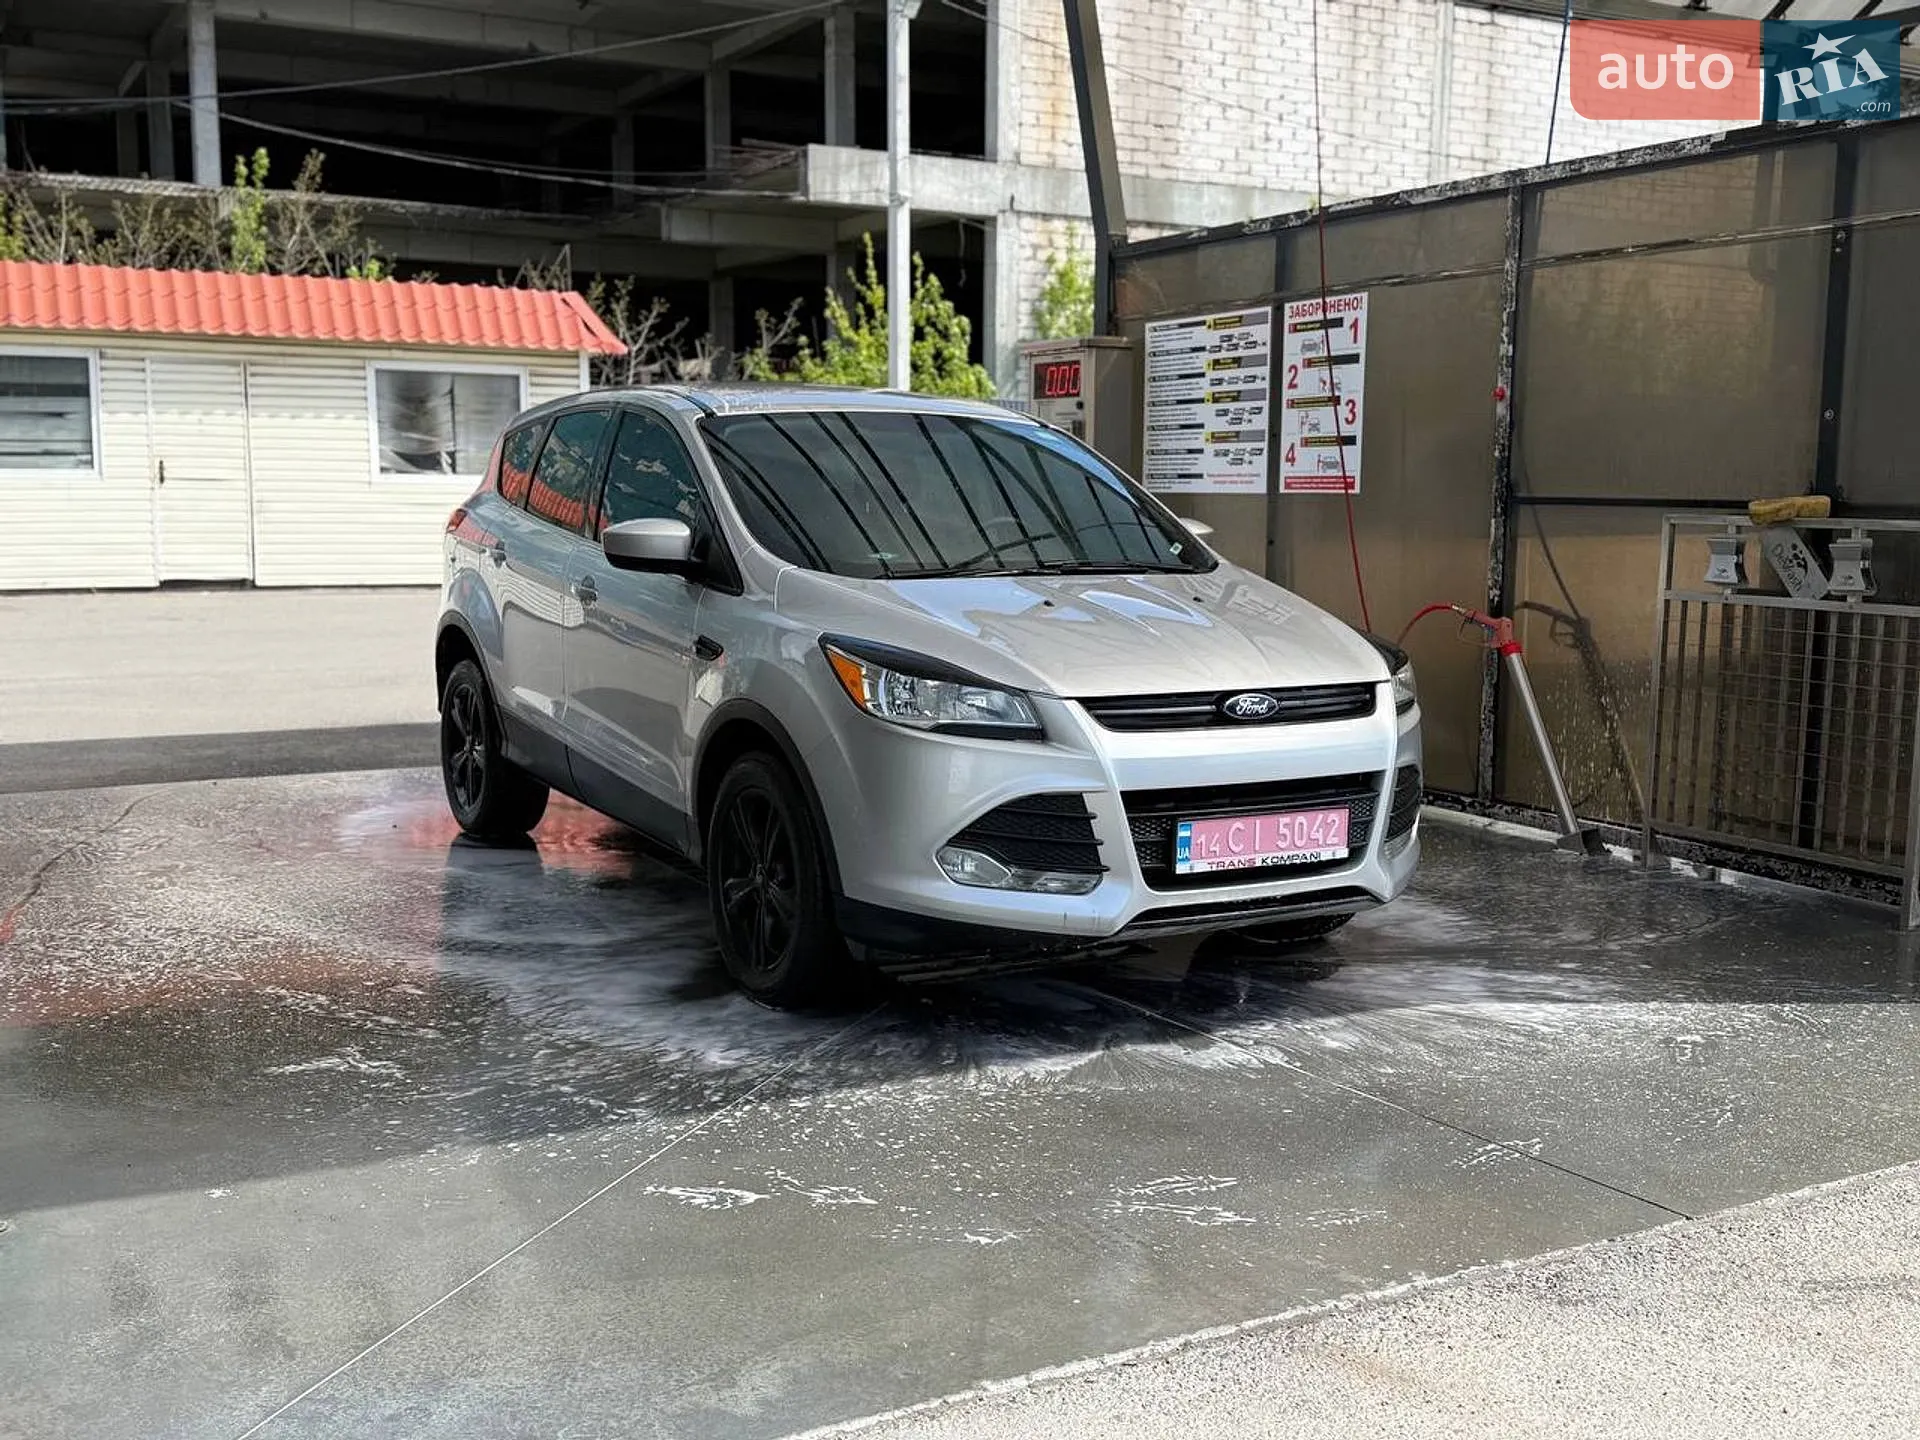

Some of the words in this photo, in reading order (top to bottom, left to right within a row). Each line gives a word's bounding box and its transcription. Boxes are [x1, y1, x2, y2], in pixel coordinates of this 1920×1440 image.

[1349, 317, 1359, 344] 1
[1287, 364, 1298, 389] 2
[1344, 398, 1356, 425] 3
[1285, 442, 1296, 467] 4
[1236, 697, 1269, 715] Ford
[1276, 813, 1341, 849] 5042
[1177, 847, 1190, 860] UA
[1207, 857, 1257, 871] TRANS
[1261, 851, 1321, 866] KOMPANI
